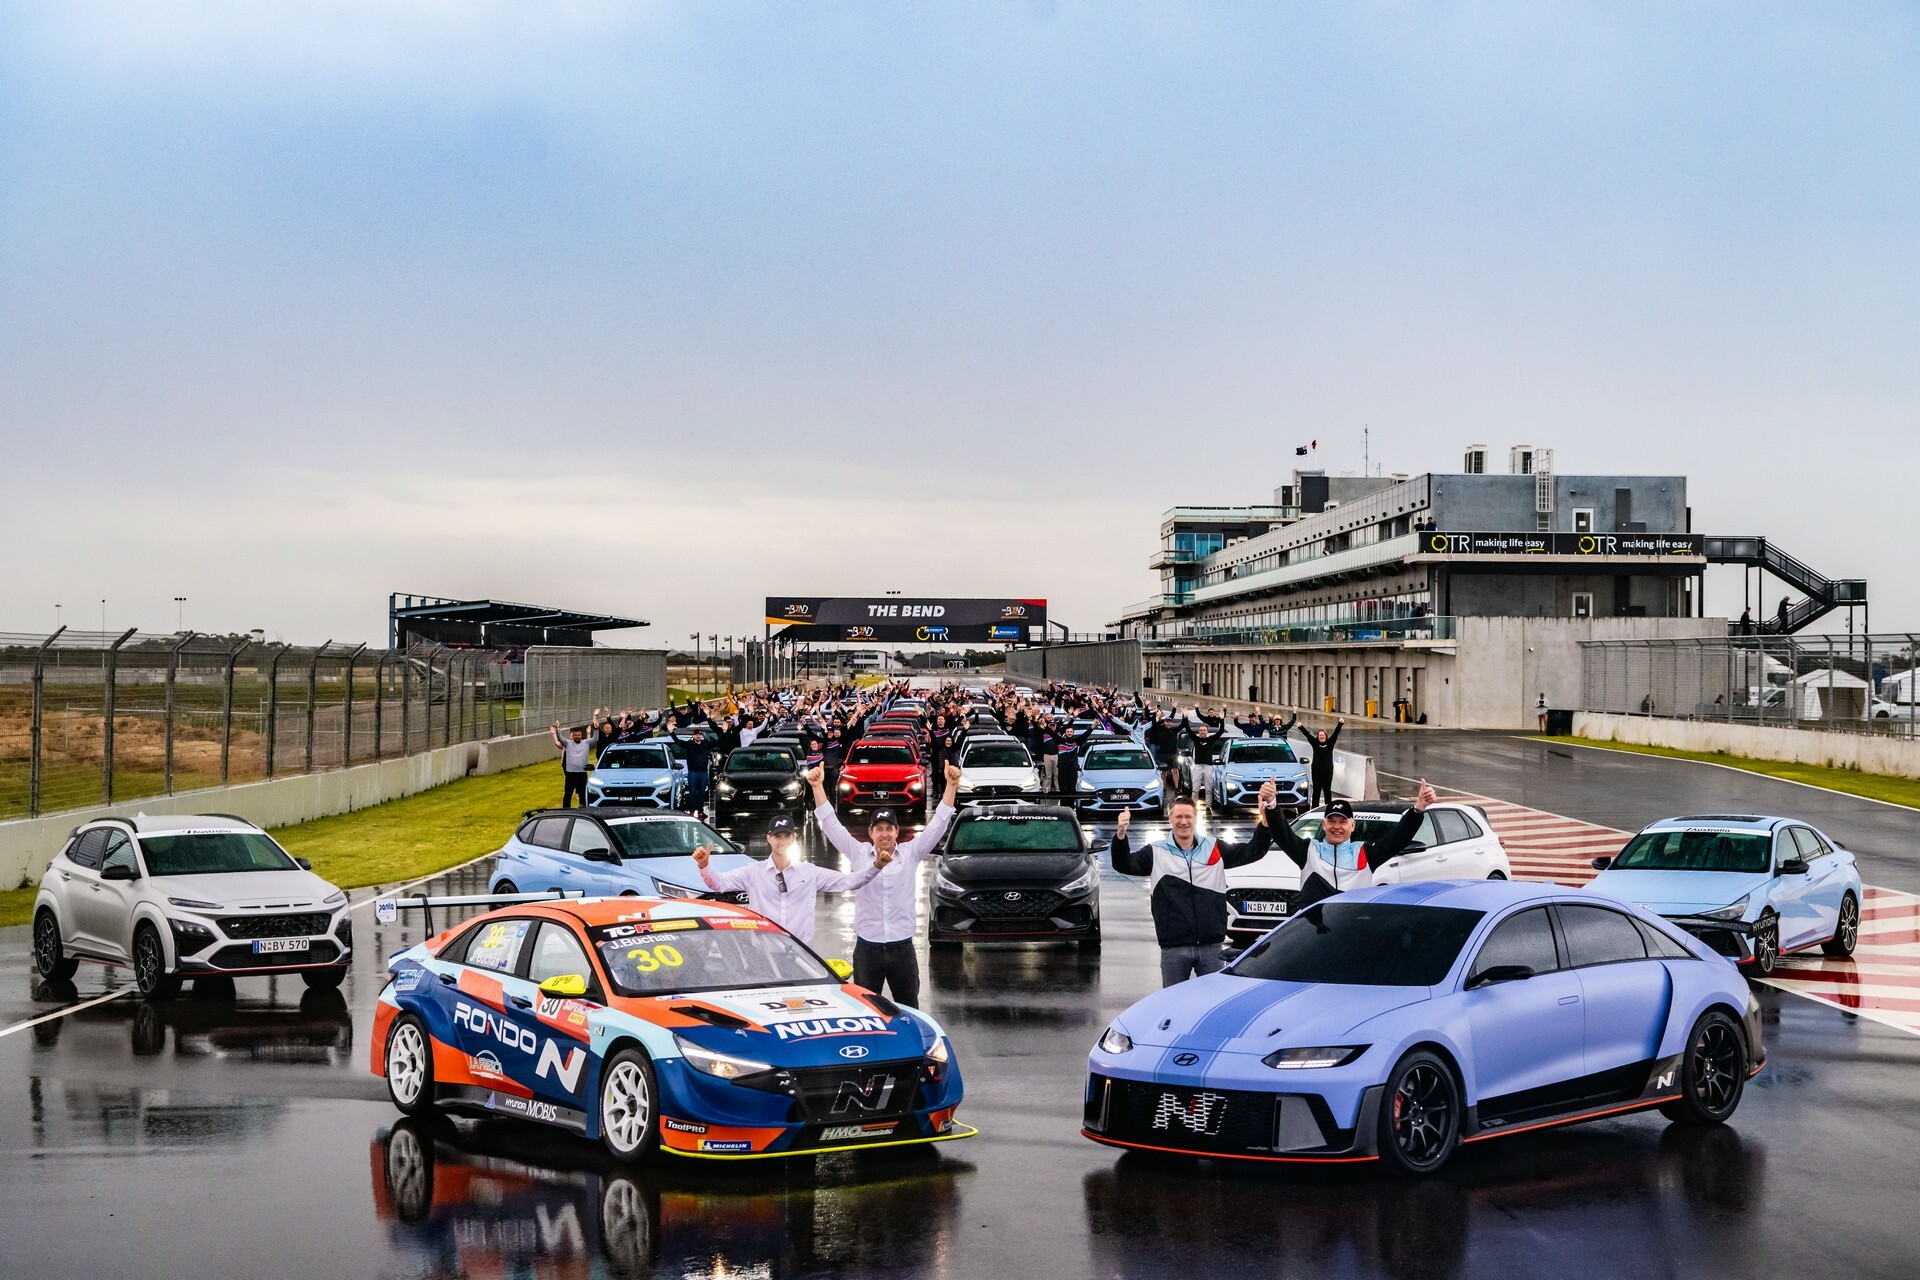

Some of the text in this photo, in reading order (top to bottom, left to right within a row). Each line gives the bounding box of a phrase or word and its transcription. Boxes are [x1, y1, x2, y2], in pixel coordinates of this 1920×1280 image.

[1431, 534, 1470, 552] OTR
[1475, 538, 1545, 550] making life easy
[1579, 535, 1617, 553] OTR
[1622, 539, 1692, 551] making life easy
[868, 604, 946, 617] THE BEND
[947, 660, 965, 669] OTR
[1269, 903, 1285, 912] 74U
[602, 921, 695, 938] TCR Australia
[708, 918, 770, 926] SUPERCHEAP
[1752, 916, 1777, 932] HYUNDAI
[288, 939, 309, 950] 57Q
[484, 924, 505, 949] 30
[627, 944, 684, 973] 30
[541, 998, 561, 1016] 30
[453, 1001, 537, 1055] RONDO
[776, 1017, 887, 1040] NULON
[505, 1098, 557, 1122] HYUNDAI MOBIS
[667, 1120, 706, 1134] ToolPRO
[819, 1124, 863, 1141] HMO
[712, 1141, 748, 1149] MICHELIN
